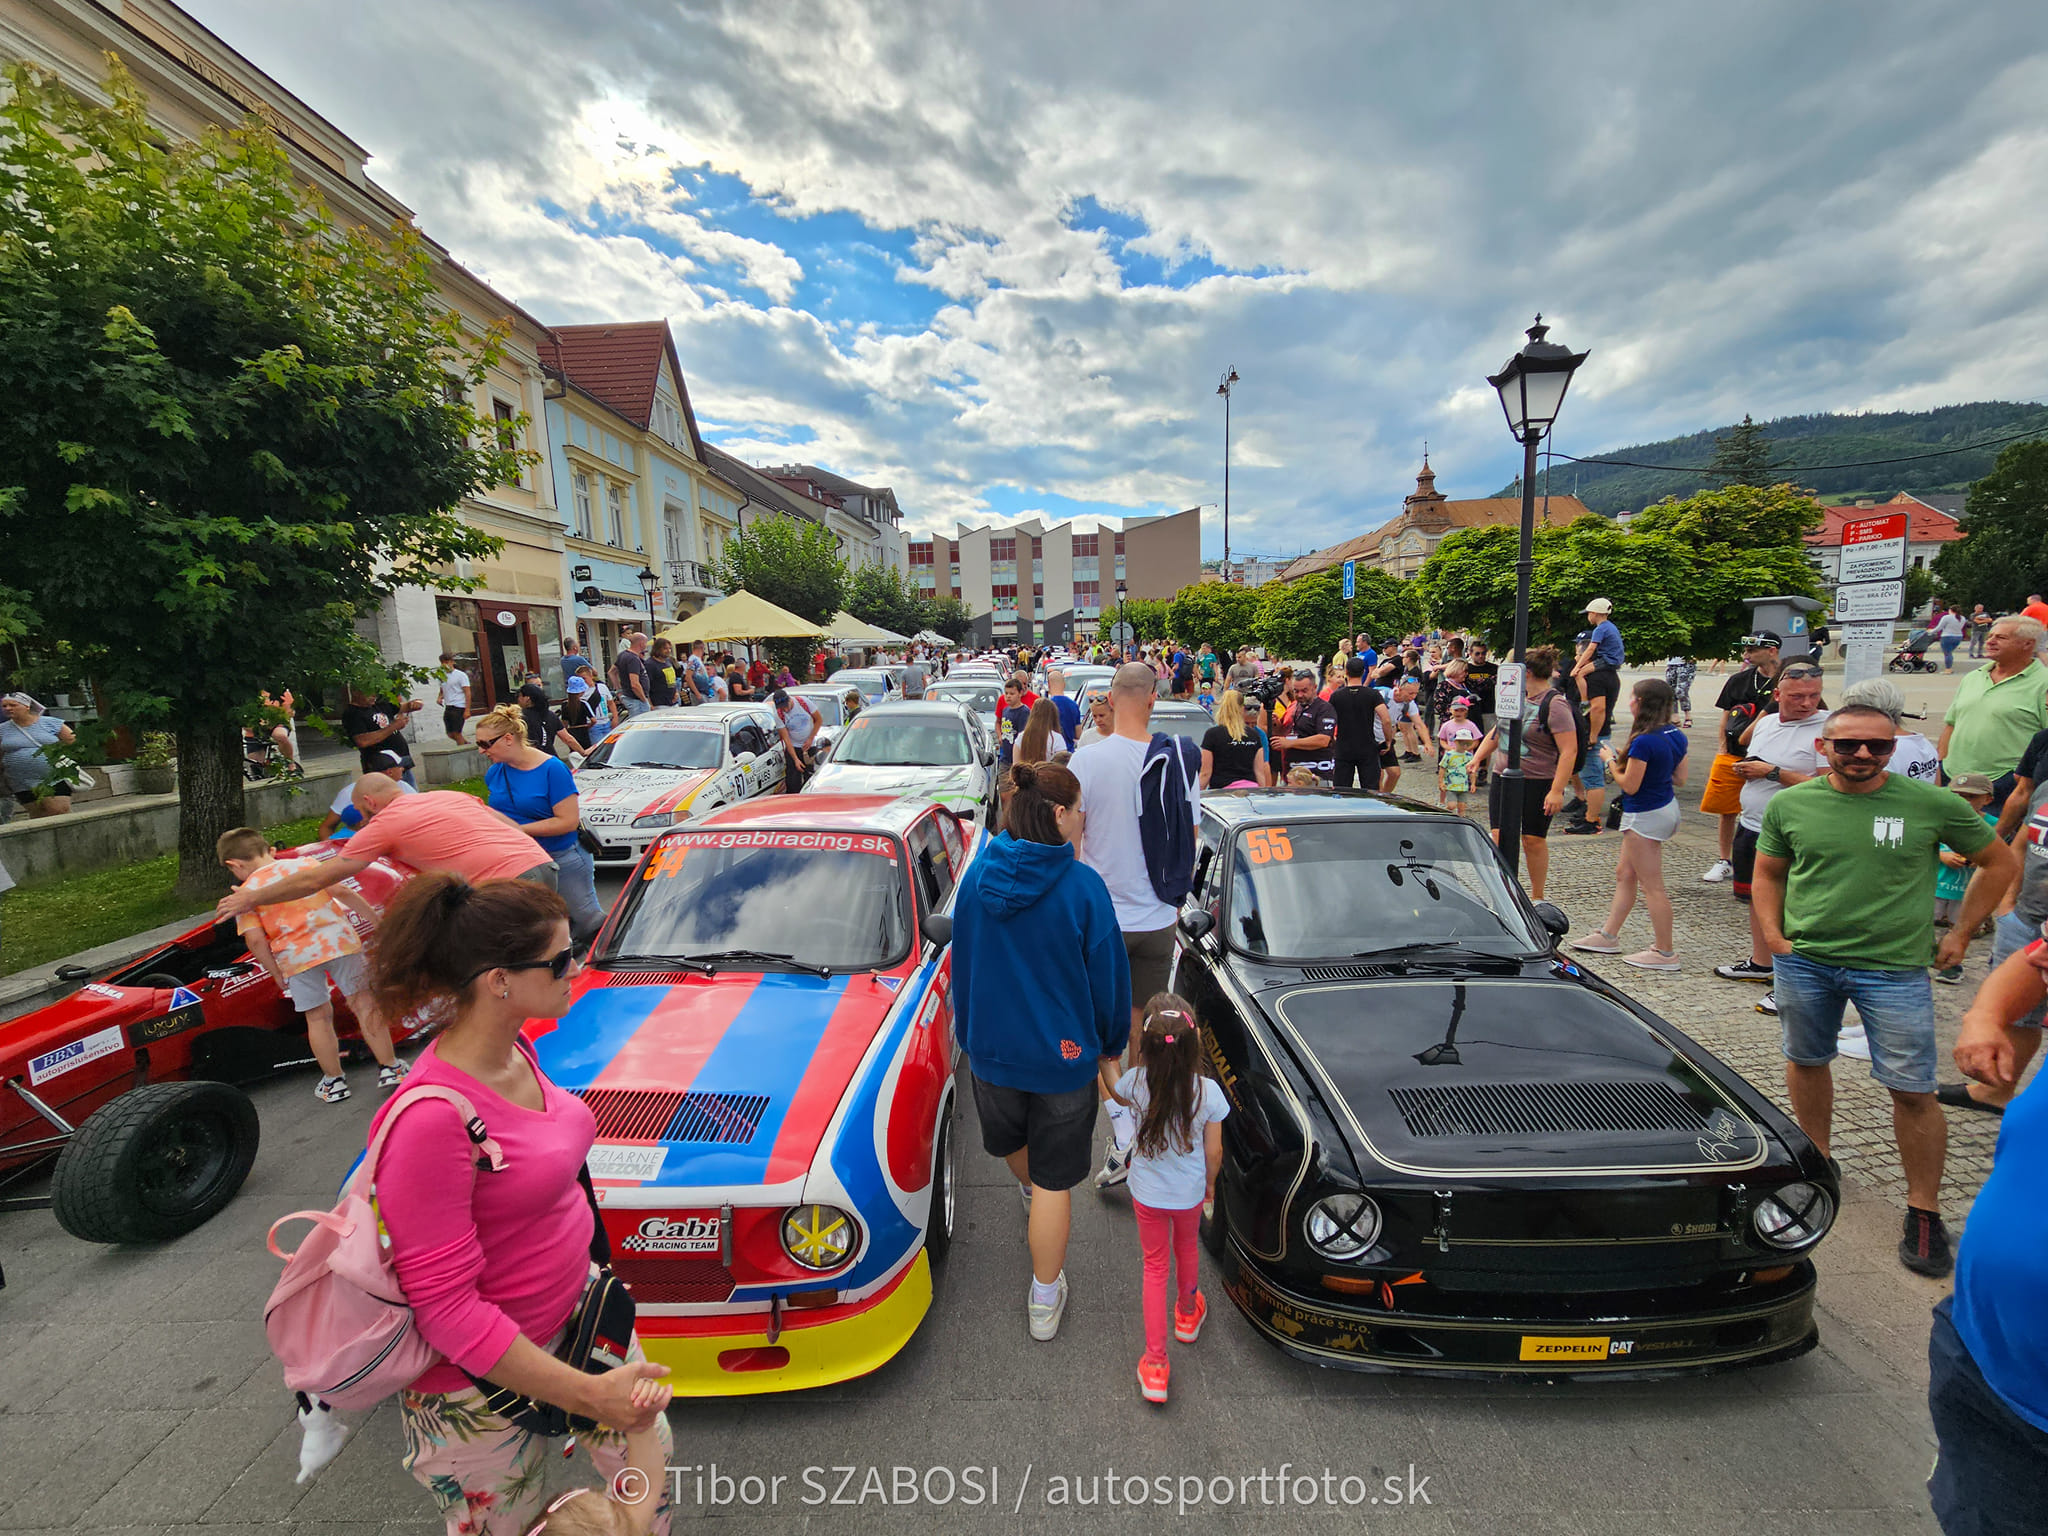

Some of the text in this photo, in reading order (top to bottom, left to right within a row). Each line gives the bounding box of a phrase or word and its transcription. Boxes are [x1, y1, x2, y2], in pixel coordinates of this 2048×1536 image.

[1860, 518, 1890, 528] AUTOMAT
[1881, 583, 1899, 592] 2200
[1792, 616, 1804, 634] P
[734, 773, 746, 798] 67
[659, 831, 890, 853] www.gabiracing.sk
[1246, 827, 1294, 864] 55
[643, 846, 690, 881] 54
[43, 1043, 77, 1068] BBN
[588, 1150, 661, 1164] EZIARNE
[639, 1218, 720, 1239] Gabi
[652, 1241, 716, 1250] RACING TEAM
[1338, 1321, 1372, 1334] s.r.o.
[1535, 1344, 1604, 1353] ZEPPELIN
[1610, 1341, 1635, 1354] CAT
